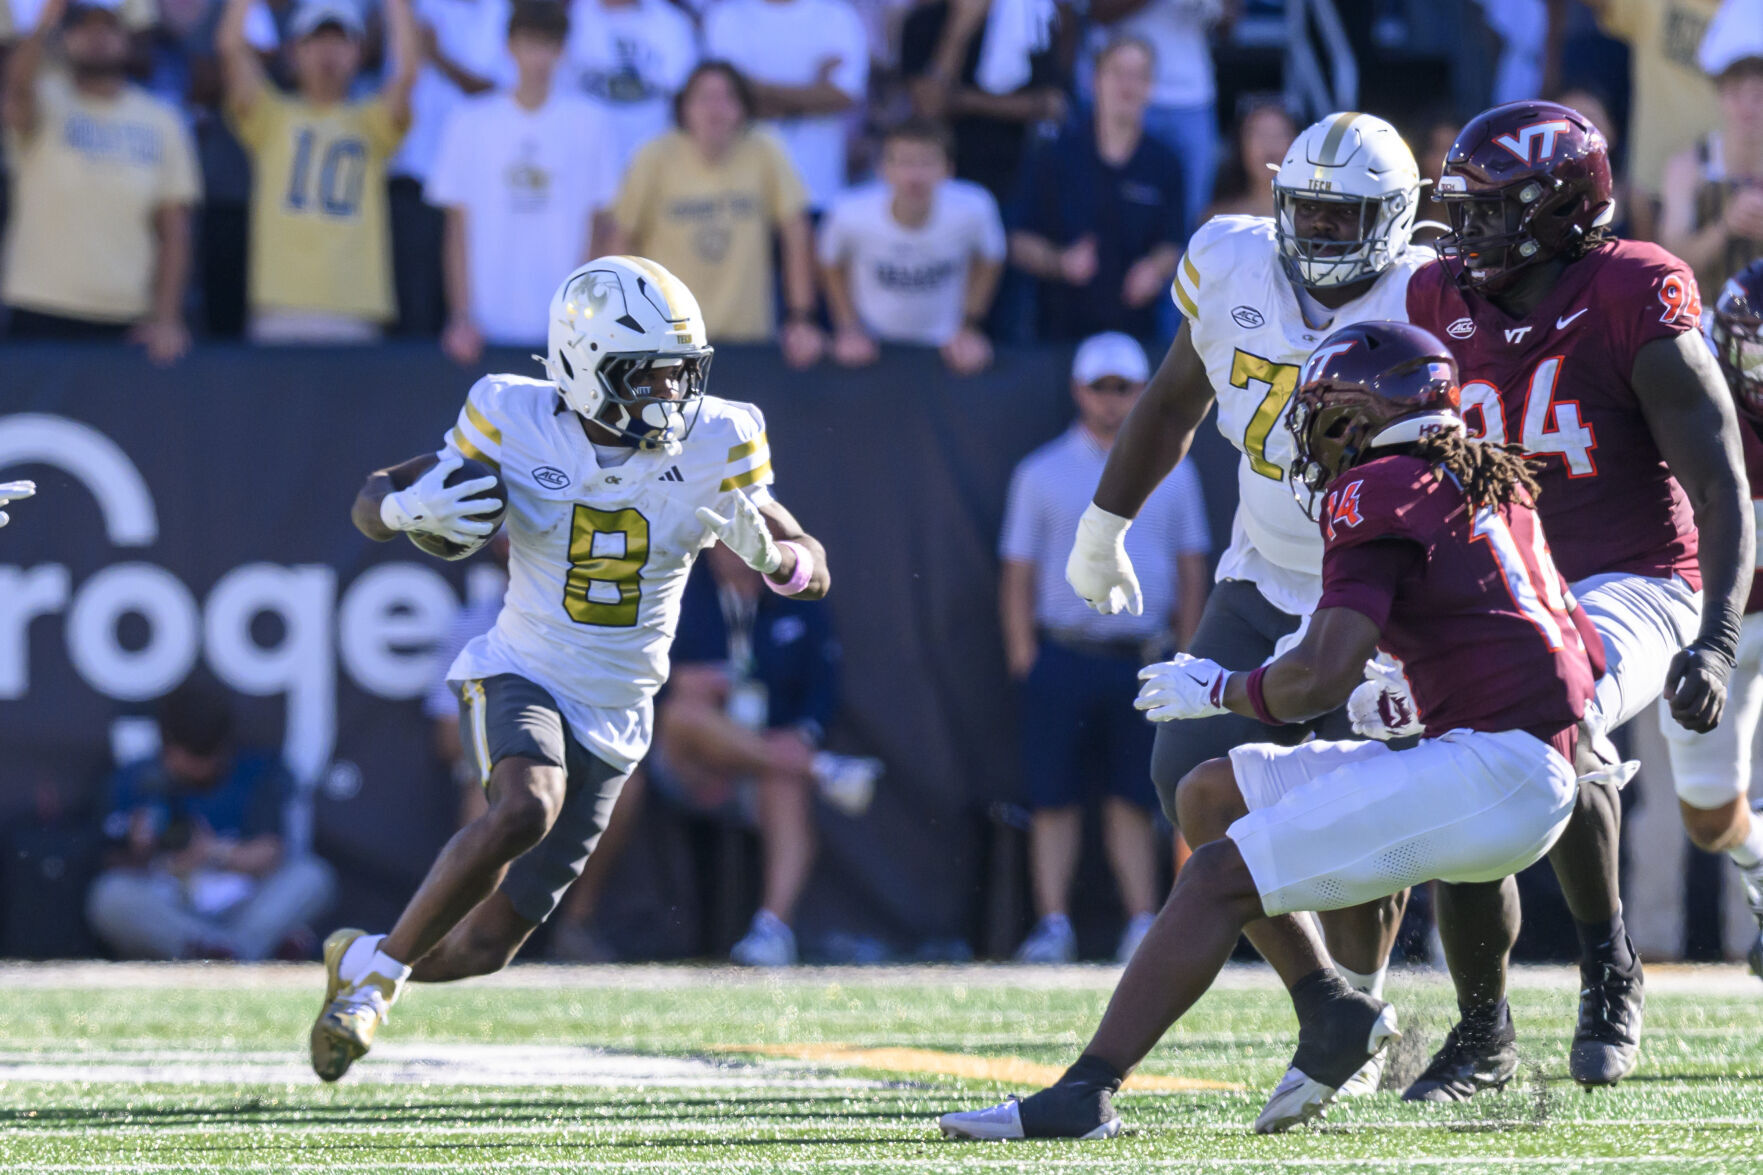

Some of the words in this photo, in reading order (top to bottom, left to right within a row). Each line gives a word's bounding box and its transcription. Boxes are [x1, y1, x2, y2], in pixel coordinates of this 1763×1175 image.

[283, 124, 366, 219] 10
[1493, 119, 1571, 168] VT
[1504, 326, 1532, 344] VT
[1327, 479, 1364, 541] 14
[563, 503, 650, 628] 8
